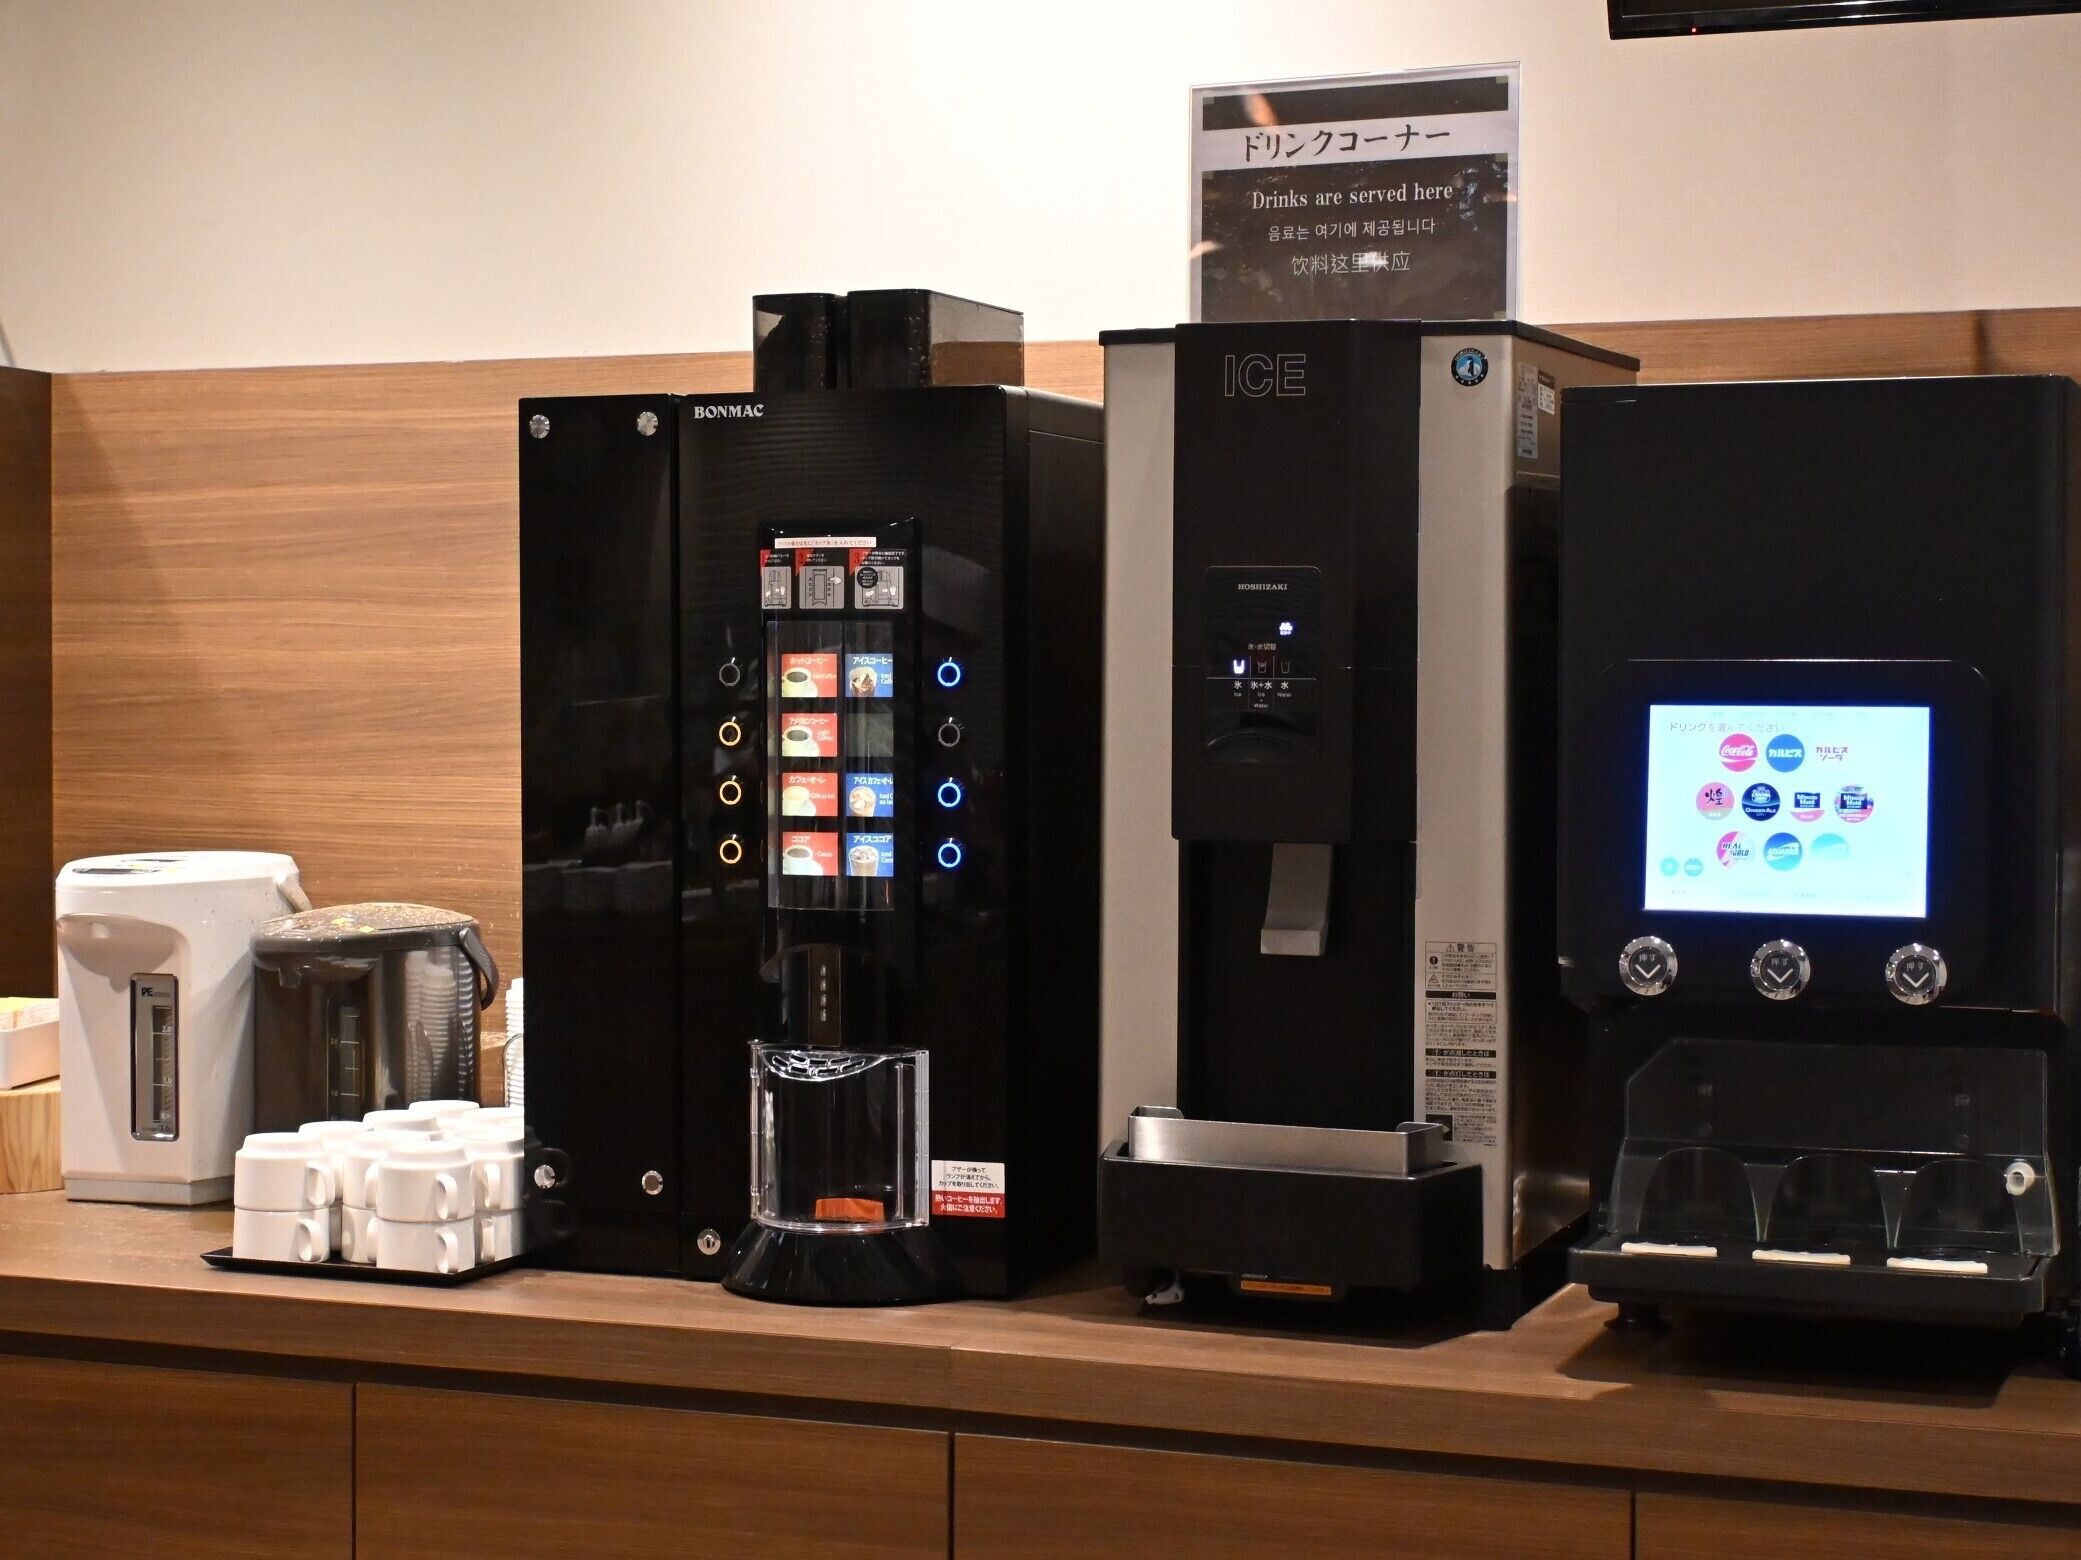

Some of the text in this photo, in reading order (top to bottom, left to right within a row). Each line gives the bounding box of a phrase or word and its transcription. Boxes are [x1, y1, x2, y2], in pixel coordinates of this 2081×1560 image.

[1245, 124, 1451, 163] ドリンクコーナー
[1251, 181, 1453, 210] Drinks are served here
[1267, 216, 1436, 242] 음료는 여기에 제공됩니다
[1292, 251, 1411, 277] 饮料这里供应
[1224, 353, 1306, 398] ICE
[694, 403, 765, 419] BONMAC
[853, 656, 893, 665] アイスコーヒー
[1768, 748, 1802, 759] カルピス
[1816, 746, 1849, 754] カルピス
[853, 835, 892, 844] アイスココア
